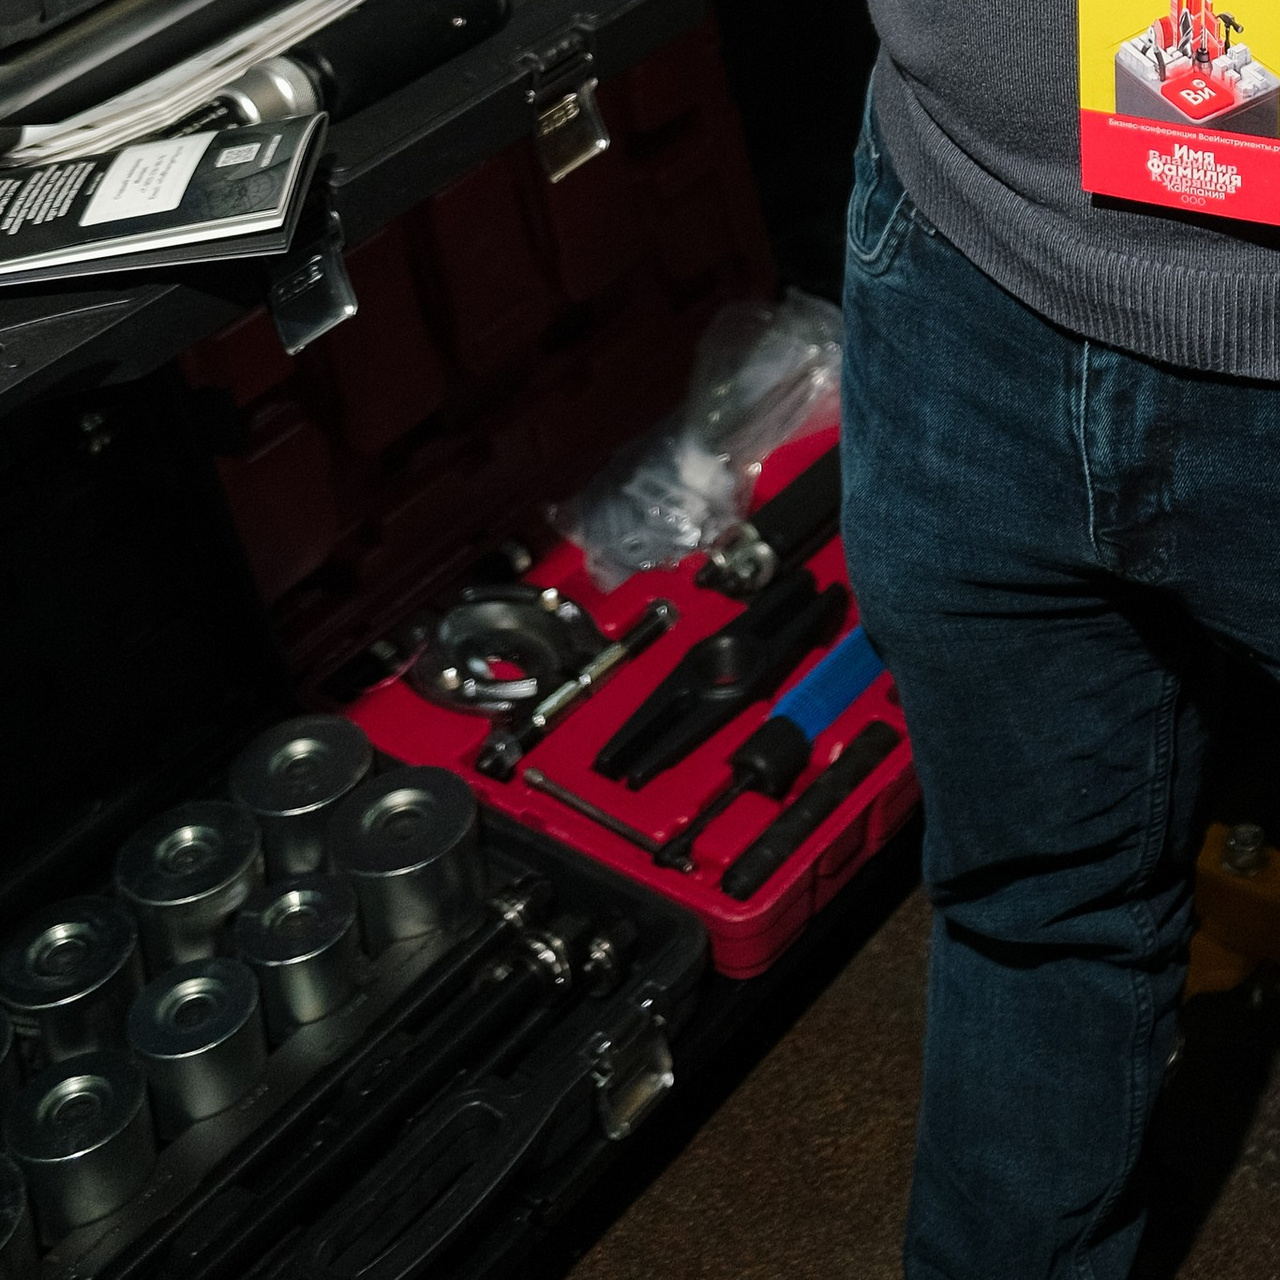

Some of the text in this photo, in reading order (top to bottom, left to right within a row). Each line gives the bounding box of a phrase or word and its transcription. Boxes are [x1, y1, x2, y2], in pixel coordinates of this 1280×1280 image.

[1108, 118, 1197, 139] Бизнес-конференция
[1173, 143, 1215, 165] Имя
[1147, 158, 1242, 187] Фамилия
[1167, 182, 1226, 200] Компания
